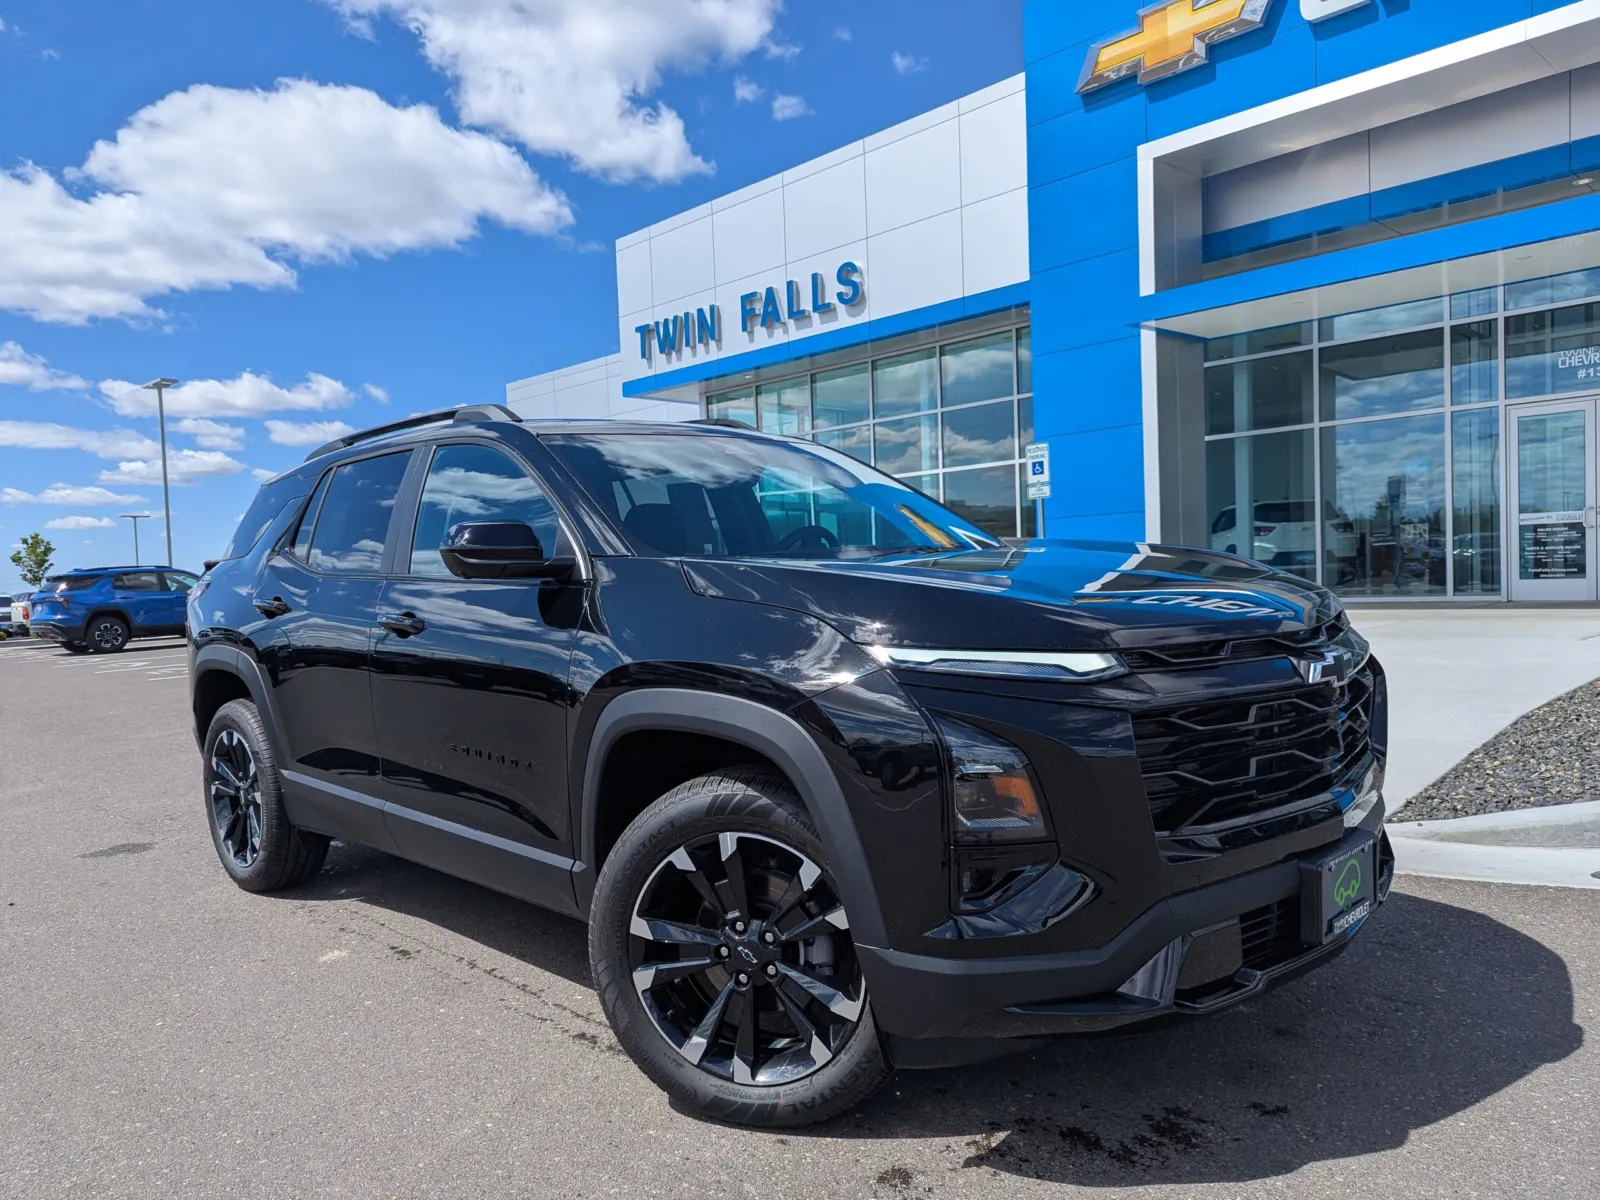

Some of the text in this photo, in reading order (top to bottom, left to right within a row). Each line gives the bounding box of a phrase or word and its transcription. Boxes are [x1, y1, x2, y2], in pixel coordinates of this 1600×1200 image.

[635, 261, 864, 359] TWIN FALLS
[1345, 901, 1370, 927] CHEVROLET
